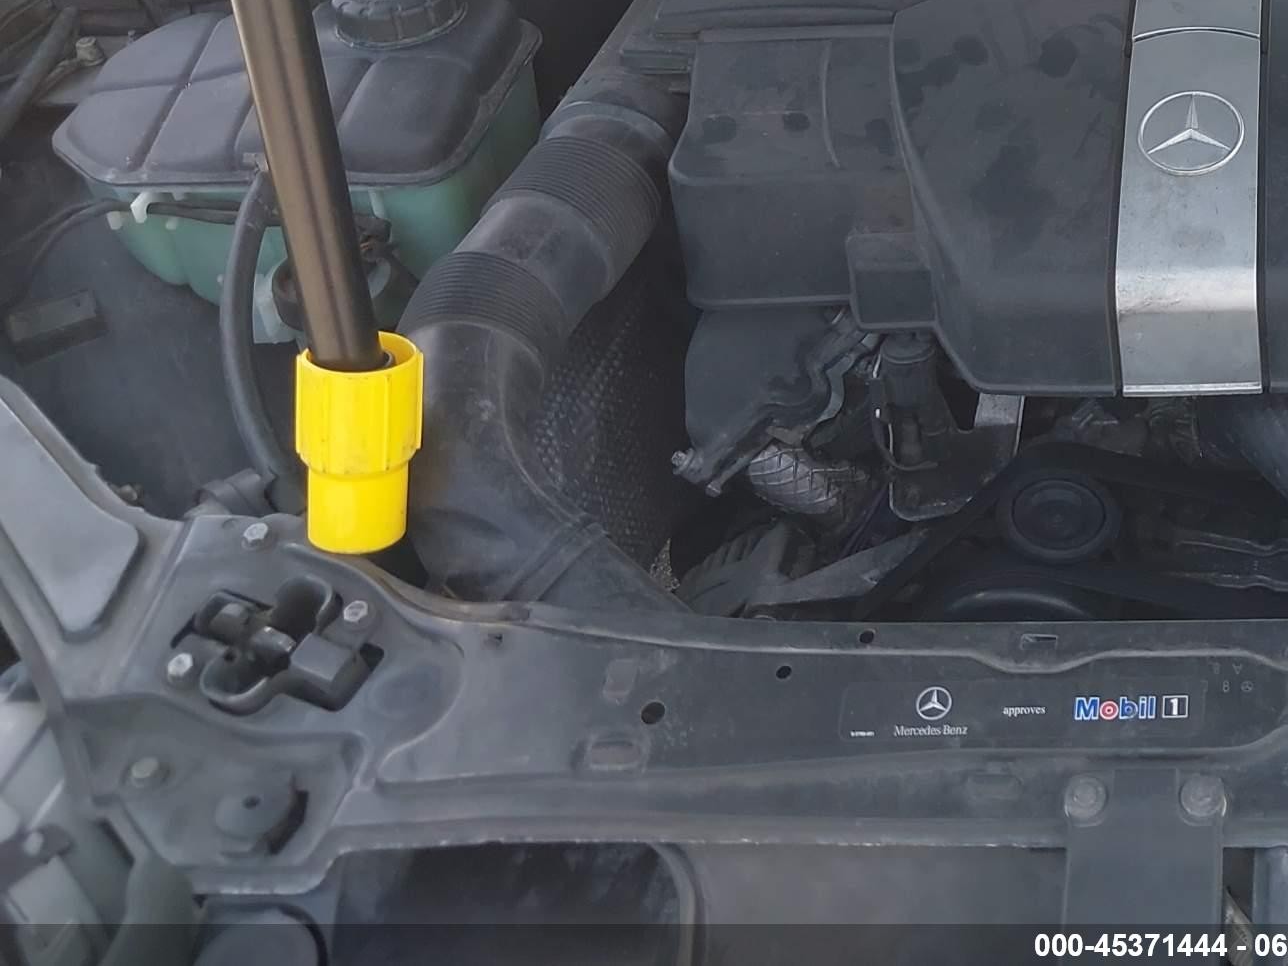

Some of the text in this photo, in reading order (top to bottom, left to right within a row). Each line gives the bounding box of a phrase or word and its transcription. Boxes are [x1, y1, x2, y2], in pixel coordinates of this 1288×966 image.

[1003, 706, 1046, 718] approves
[1074, 695, 1157, 721] Mobil
[893, 724, 968, 737] Mercedes Benz
